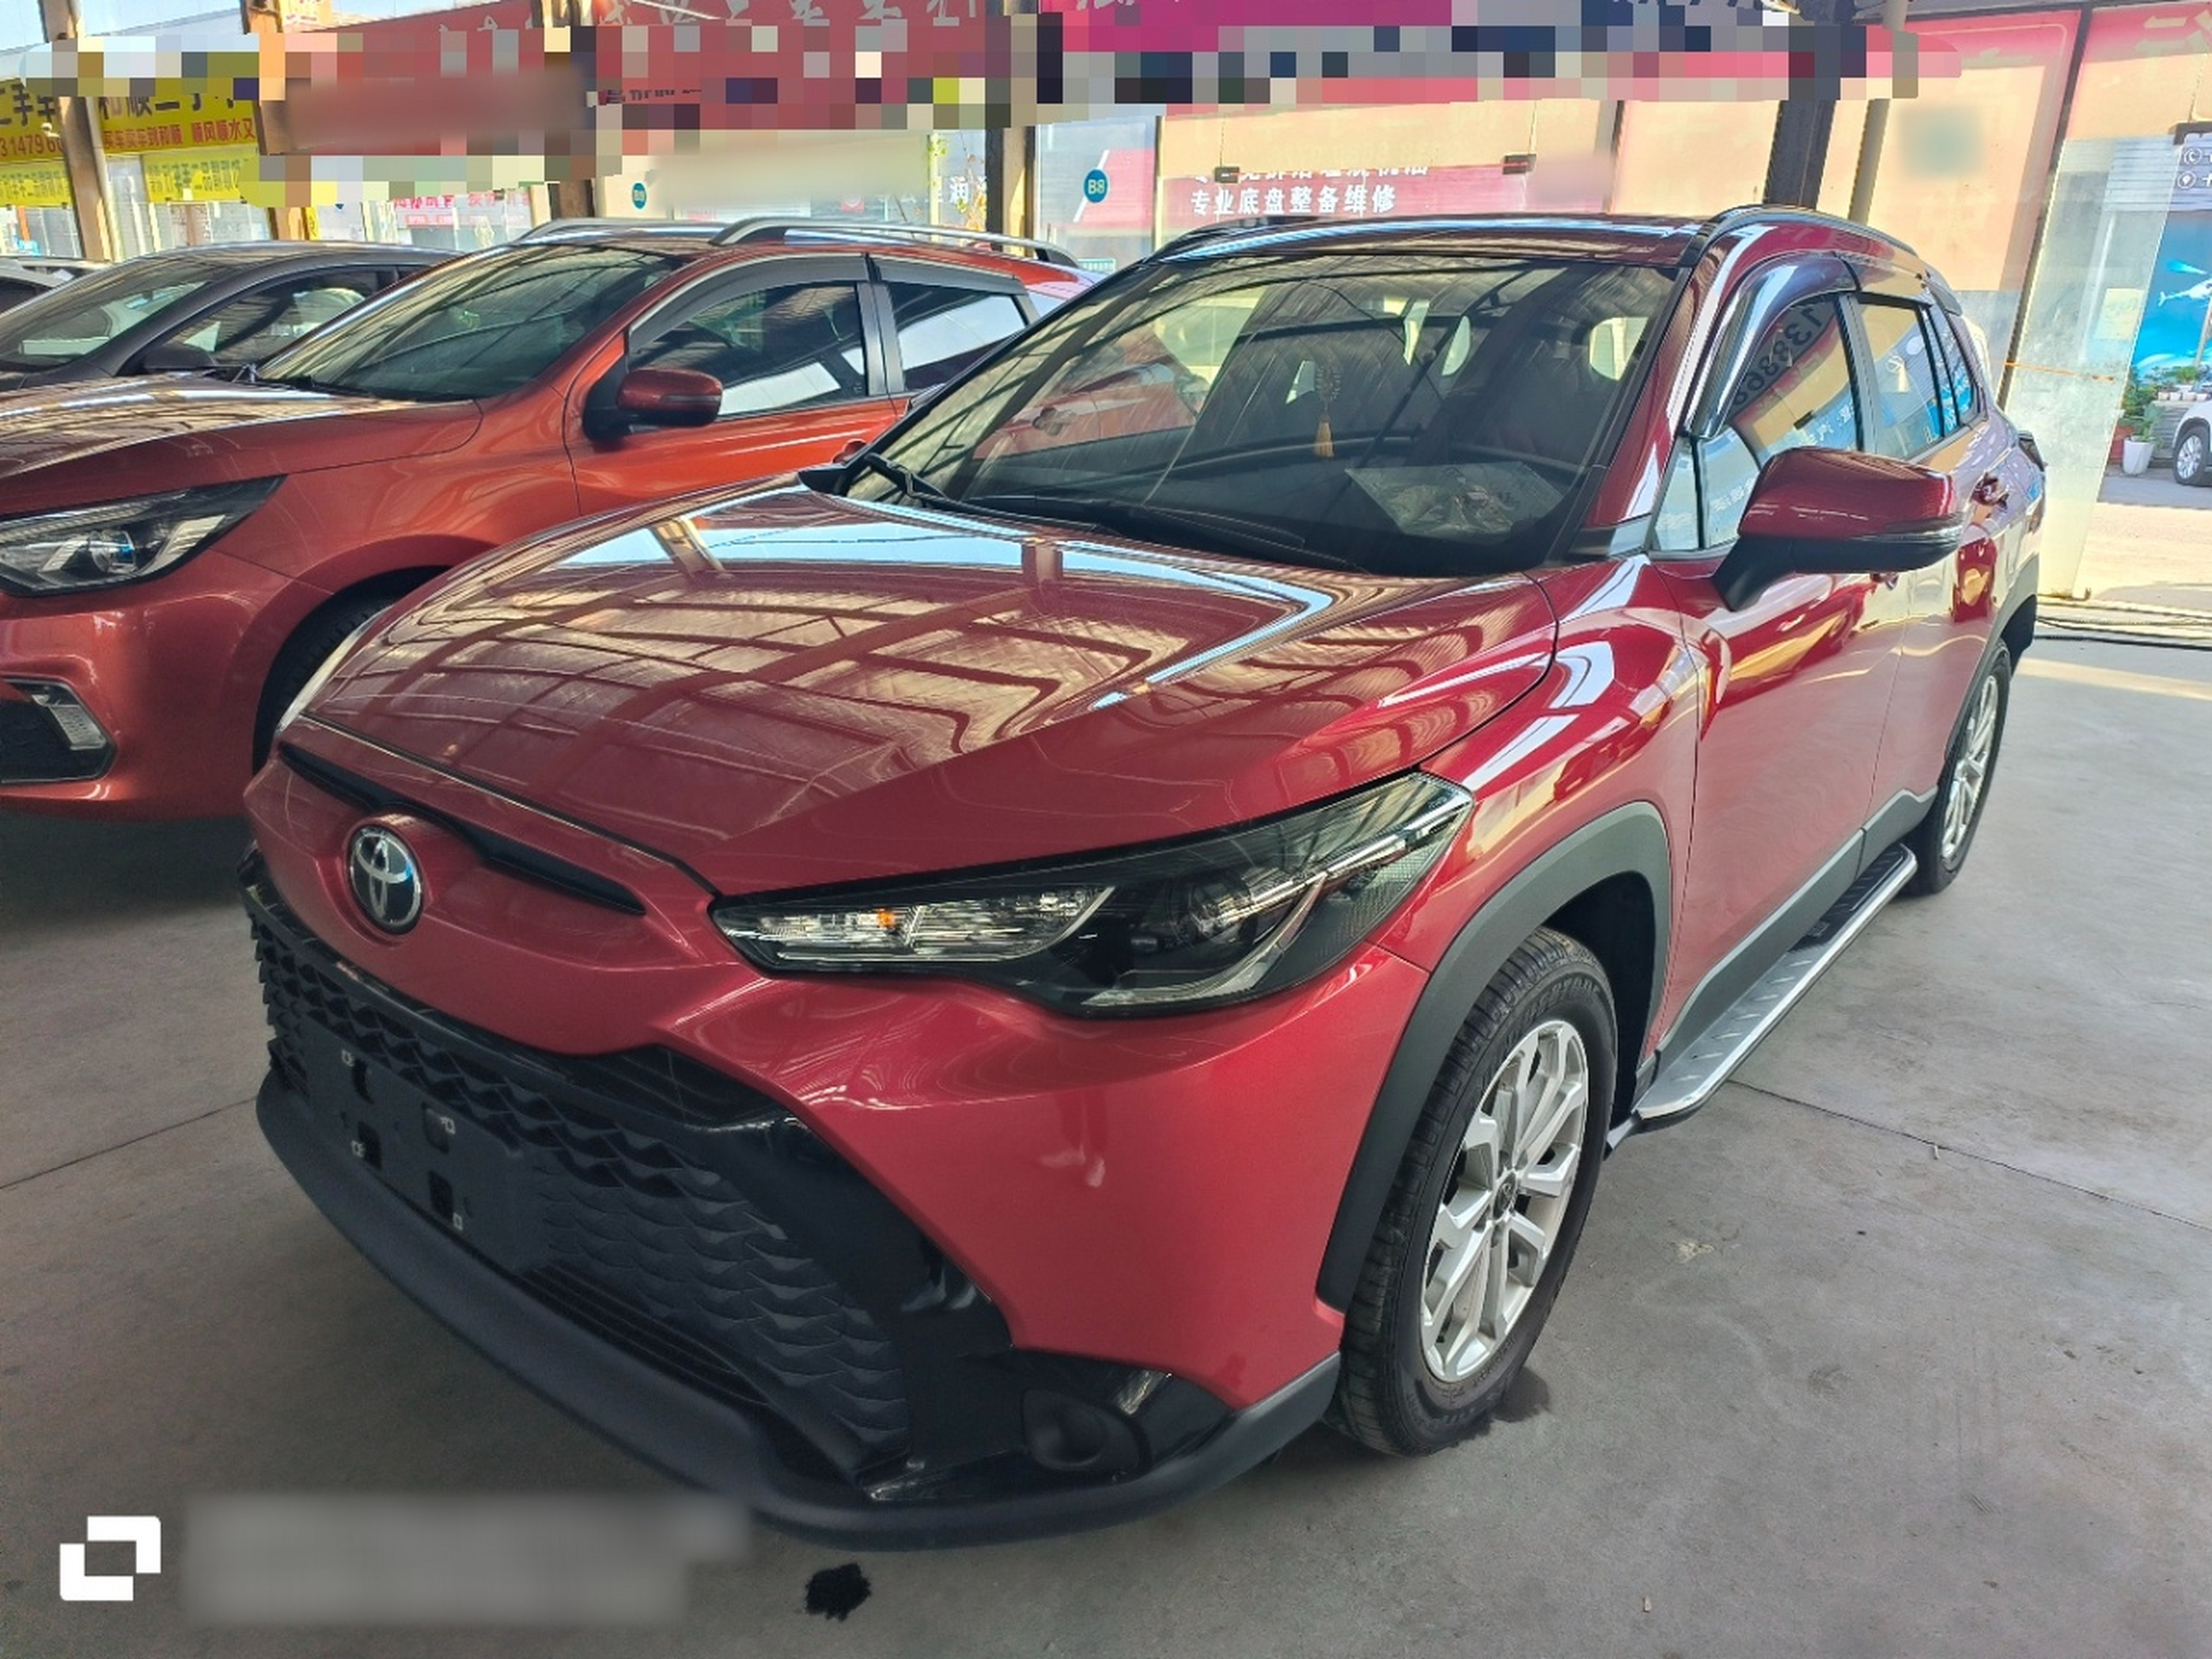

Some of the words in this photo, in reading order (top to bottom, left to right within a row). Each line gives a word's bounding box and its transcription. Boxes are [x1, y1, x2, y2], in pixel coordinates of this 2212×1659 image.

[1088, 179, 1105, 194] B8
[1191, 184, 1396, 216] 专业底盘整备维修
